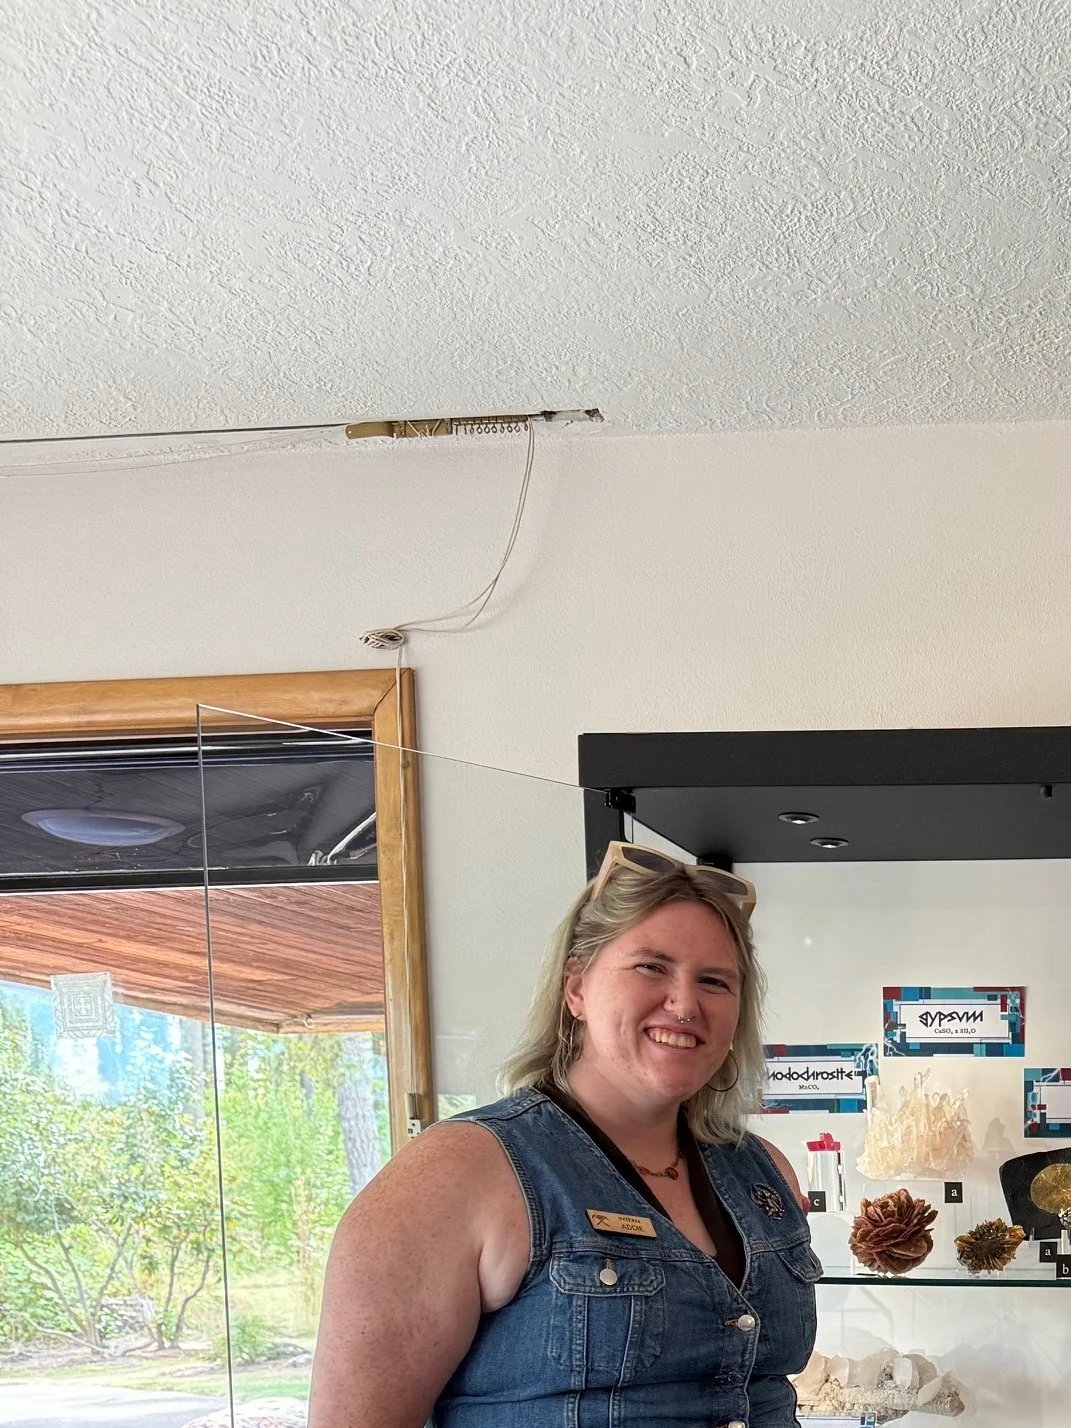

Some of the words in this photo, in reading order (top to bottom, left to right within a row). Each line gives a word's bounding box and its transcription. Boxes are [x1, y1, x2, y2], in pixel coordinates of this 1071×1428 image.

[919, 1010, 983, 1027] gypsum
[767, 1066, 854, 1083] hodochrosite
[813, 1198, 820, 1206] c
[1045, 1246, 1051, 1256] a
[1062, 1264, 1069, 1274] b
